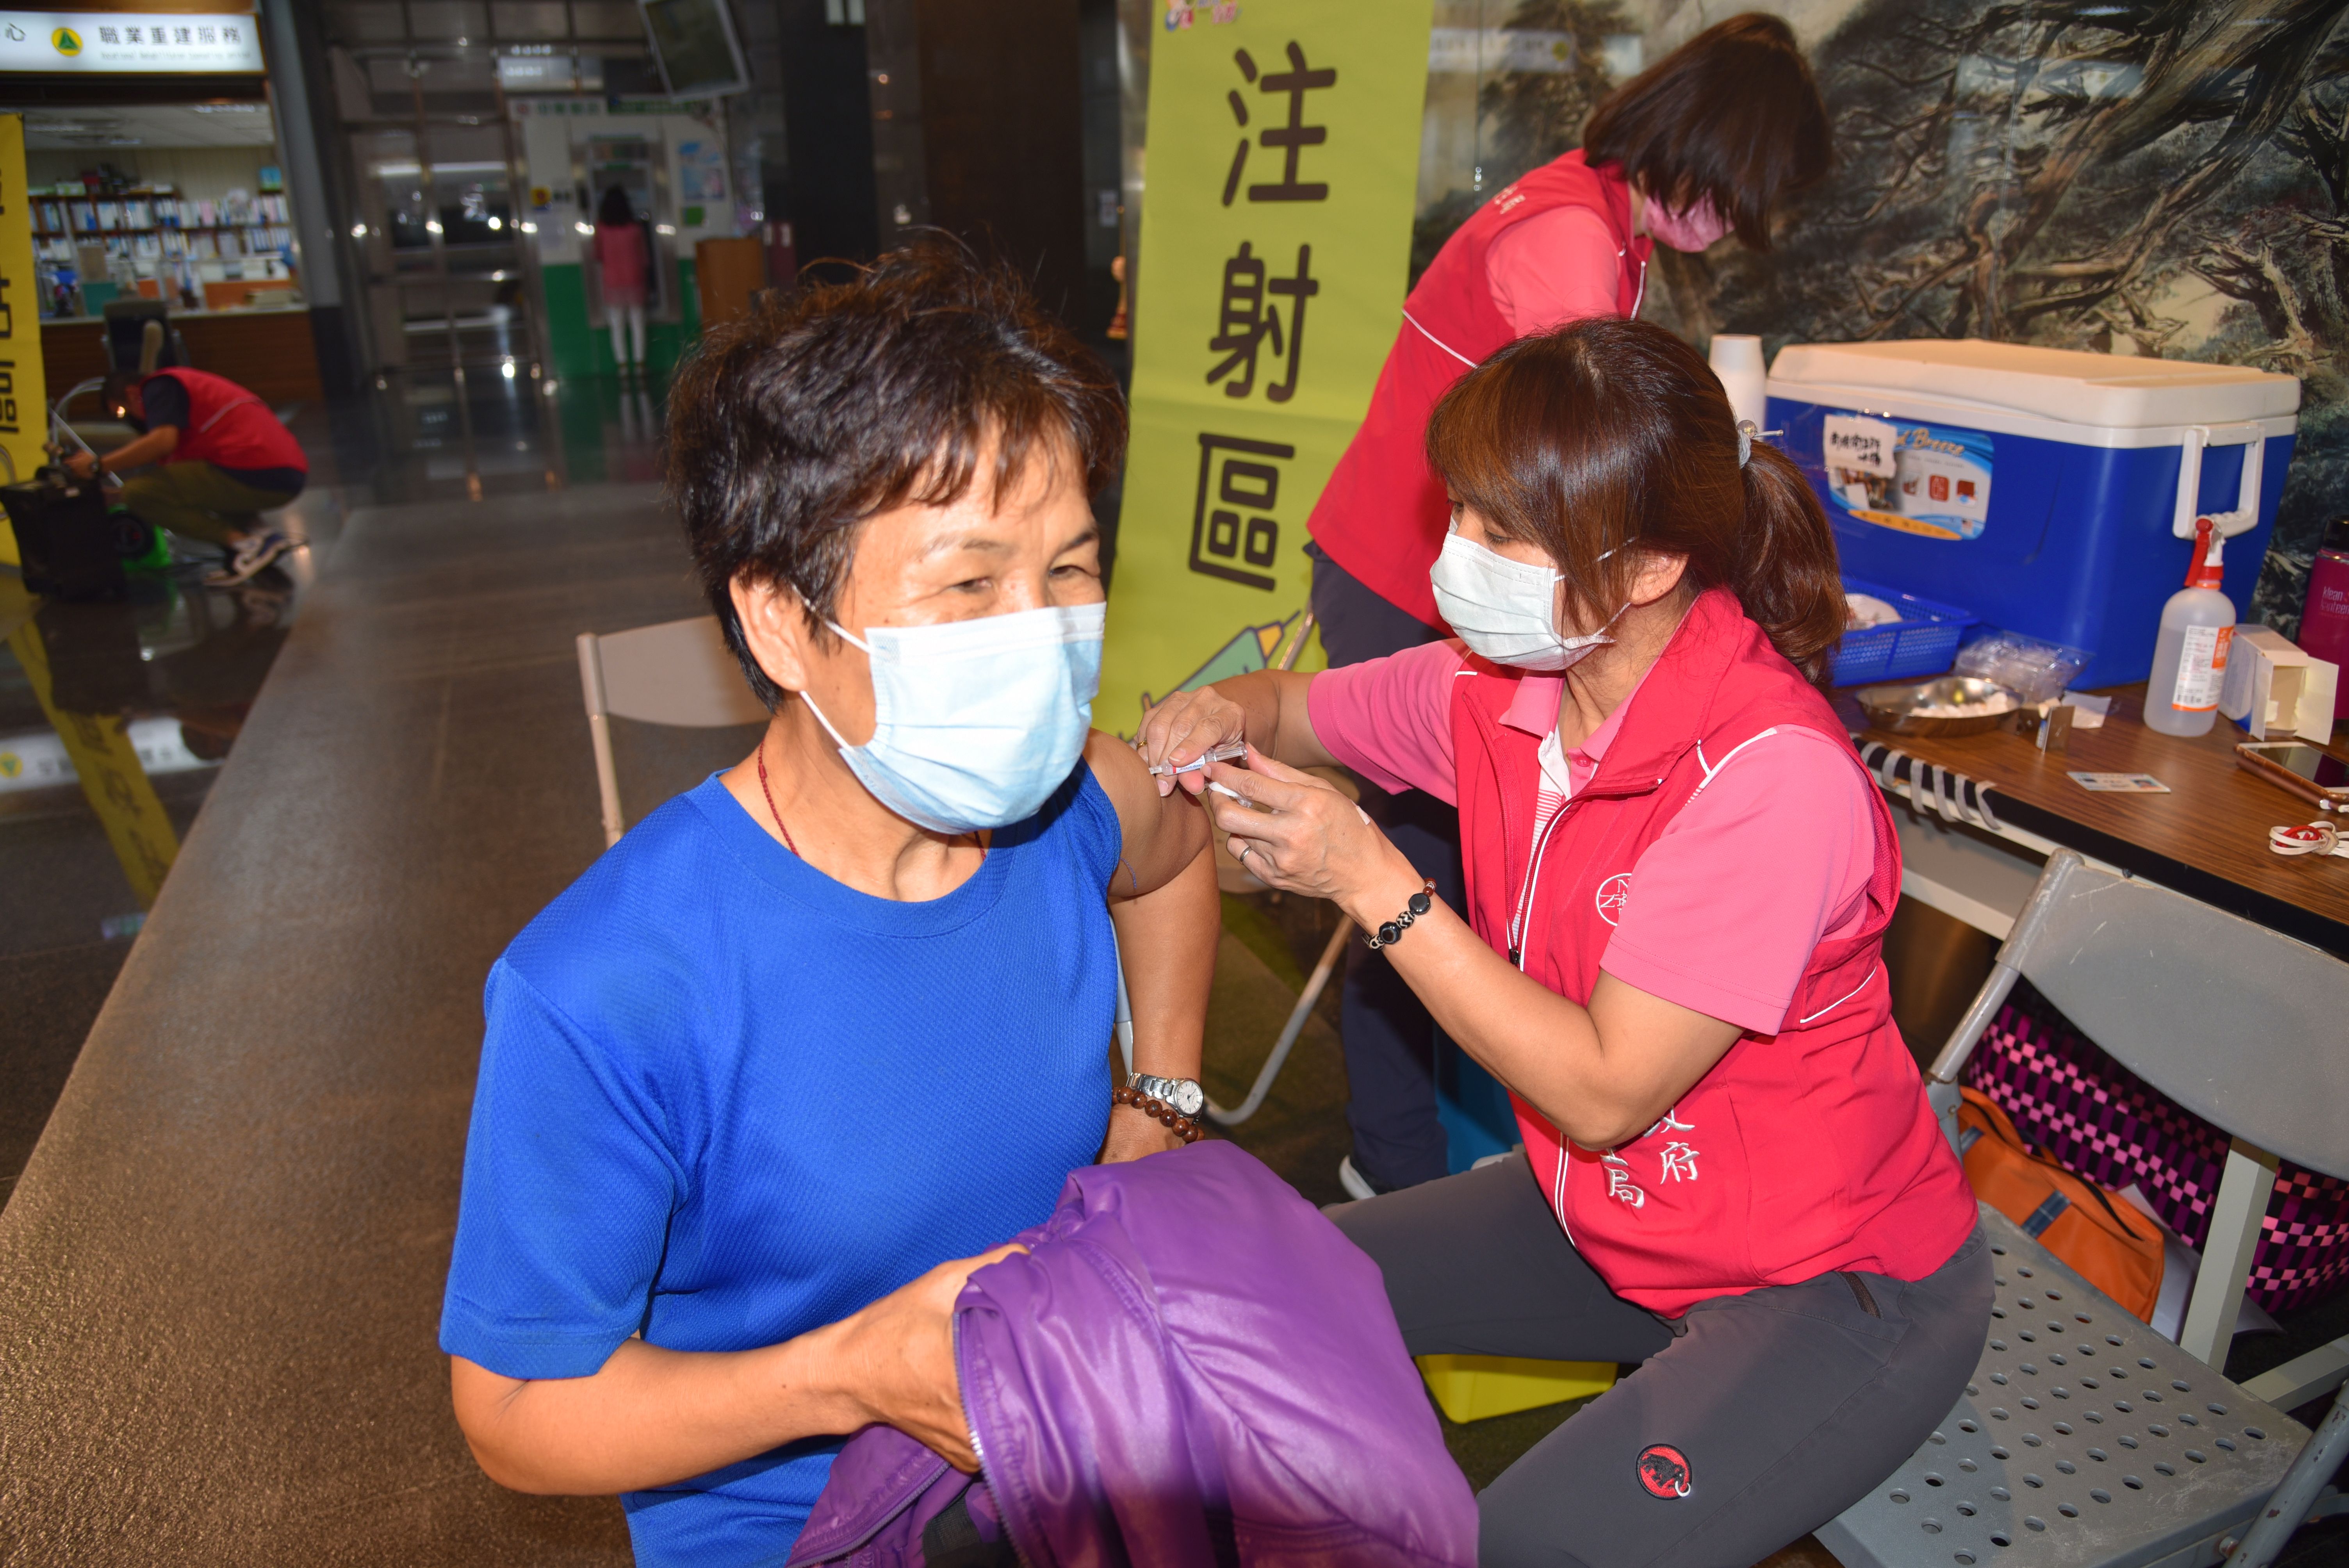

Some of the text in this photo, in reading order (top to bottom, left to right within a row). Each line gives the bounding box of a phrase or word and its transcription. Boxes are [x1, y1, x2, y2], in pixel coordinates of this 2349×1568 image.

[1189, 40, 1337, 591] 注射區
[1912, 427, 1965, 457] Breeze
[2322, 586, 2343, 602] klean
